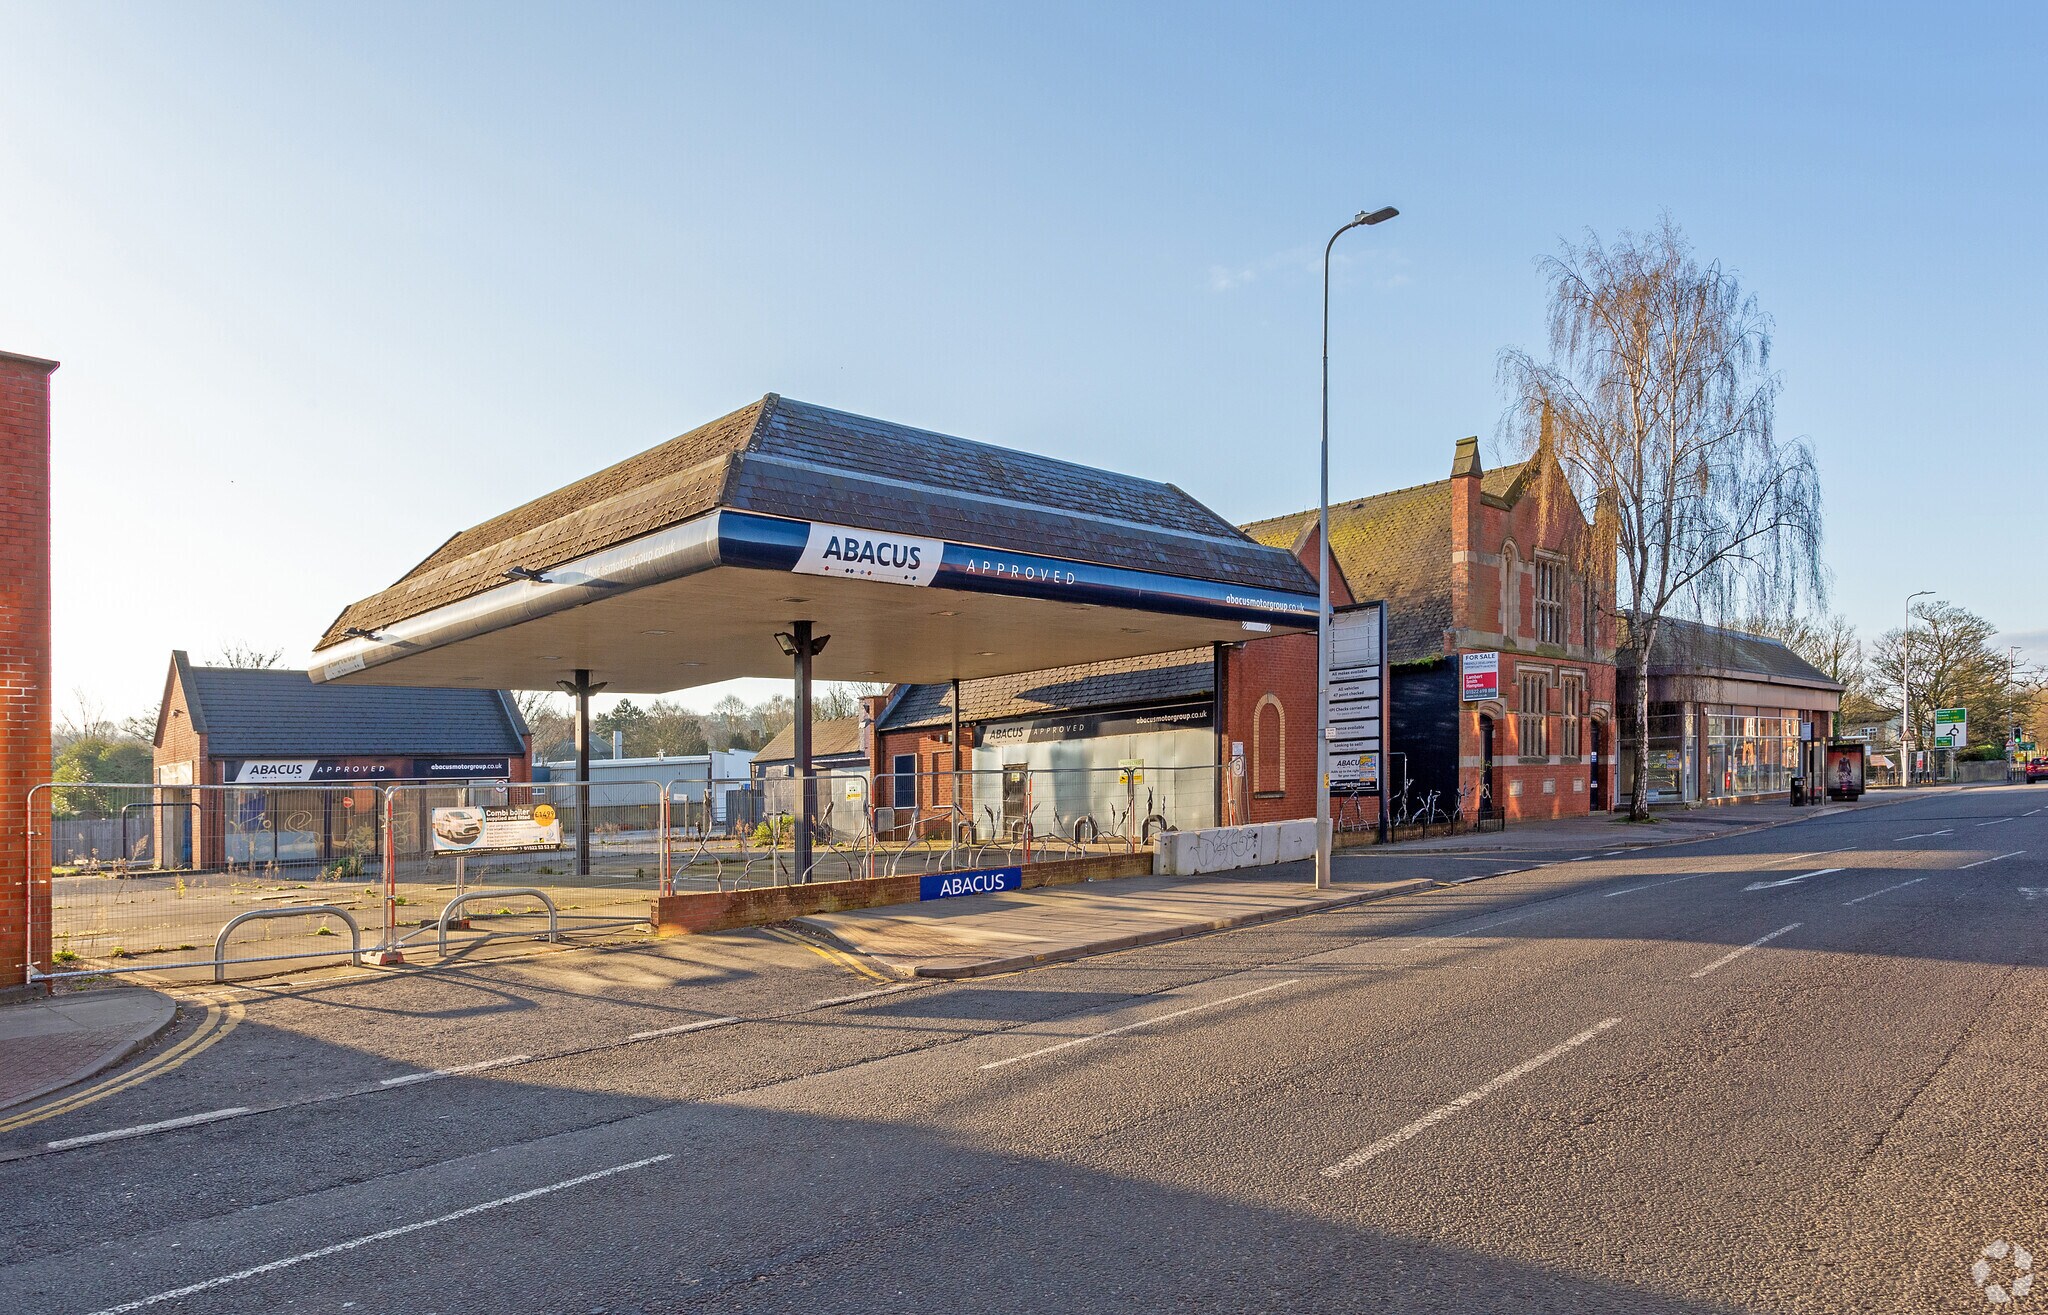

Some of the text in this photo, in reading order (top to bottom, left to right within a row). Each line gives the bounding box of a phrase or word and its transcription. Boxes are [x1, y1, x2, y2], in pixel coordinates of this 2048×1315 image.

[822, 535, 1075, 585] ABACUS APPROVED
[1226, 594, 1305, 612] abacusmotorgroup.co.uk
[1135, 710, 1208, 725] abacusmotorgroup.co.uk
[989, 723, 1085, 740] ABACUS APPROVED
[249, 763, 503, 775] ABACUS APPROVED abacusmotorgroup.co.uk
[486, 808, 531, 818] Combi boiler
[534, 810, 555, 818] £1499
[940, 874, 1004, 896] ABACUS
